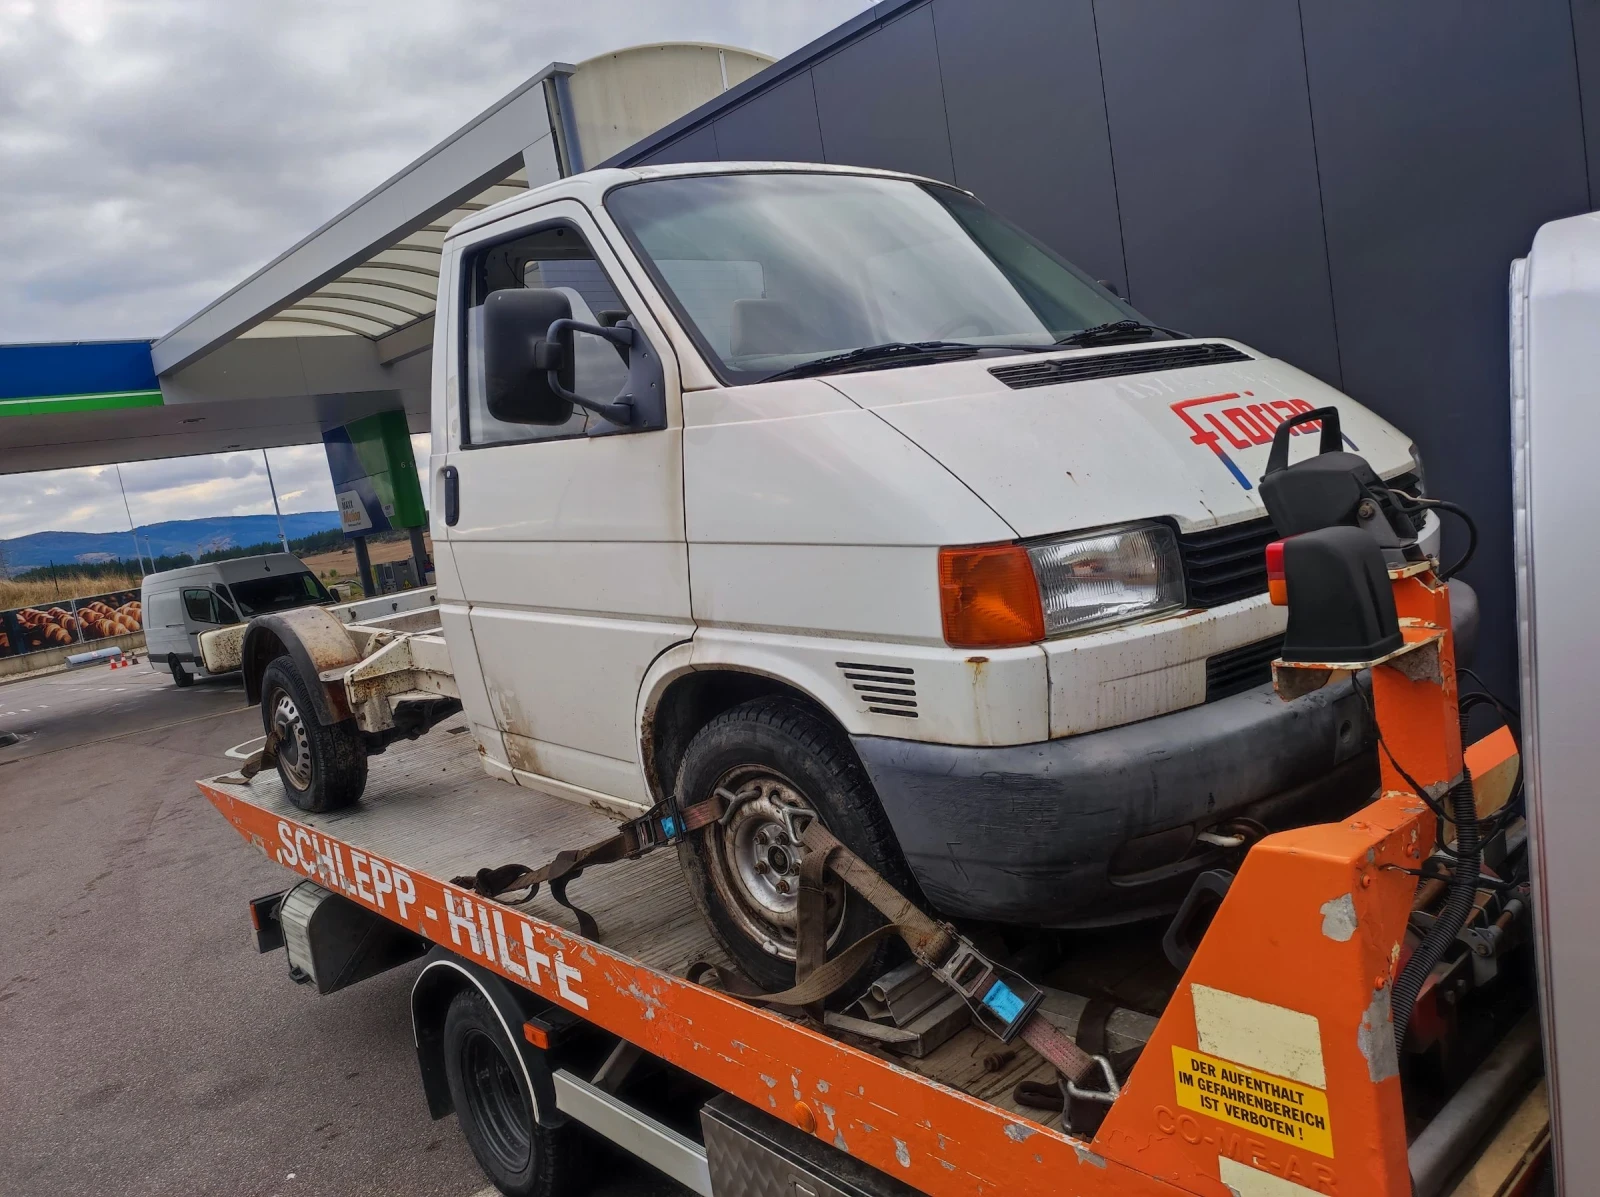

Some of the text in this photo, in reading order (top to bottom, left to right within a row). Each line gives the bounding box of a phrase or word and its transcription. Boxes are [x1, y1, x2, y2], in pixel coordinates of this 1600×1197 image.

[276, 820, 417, 921] SCHLEPP
[1178, 1070, 1326, 1130] IM GEFAHRENBEREICH
[1191, 1058, 1305, 1105] DER AUFENTHALT
[1200, 1094, 1220, 1112] IST
[1223, 1102, 1295, 1138] VERBOTEN
